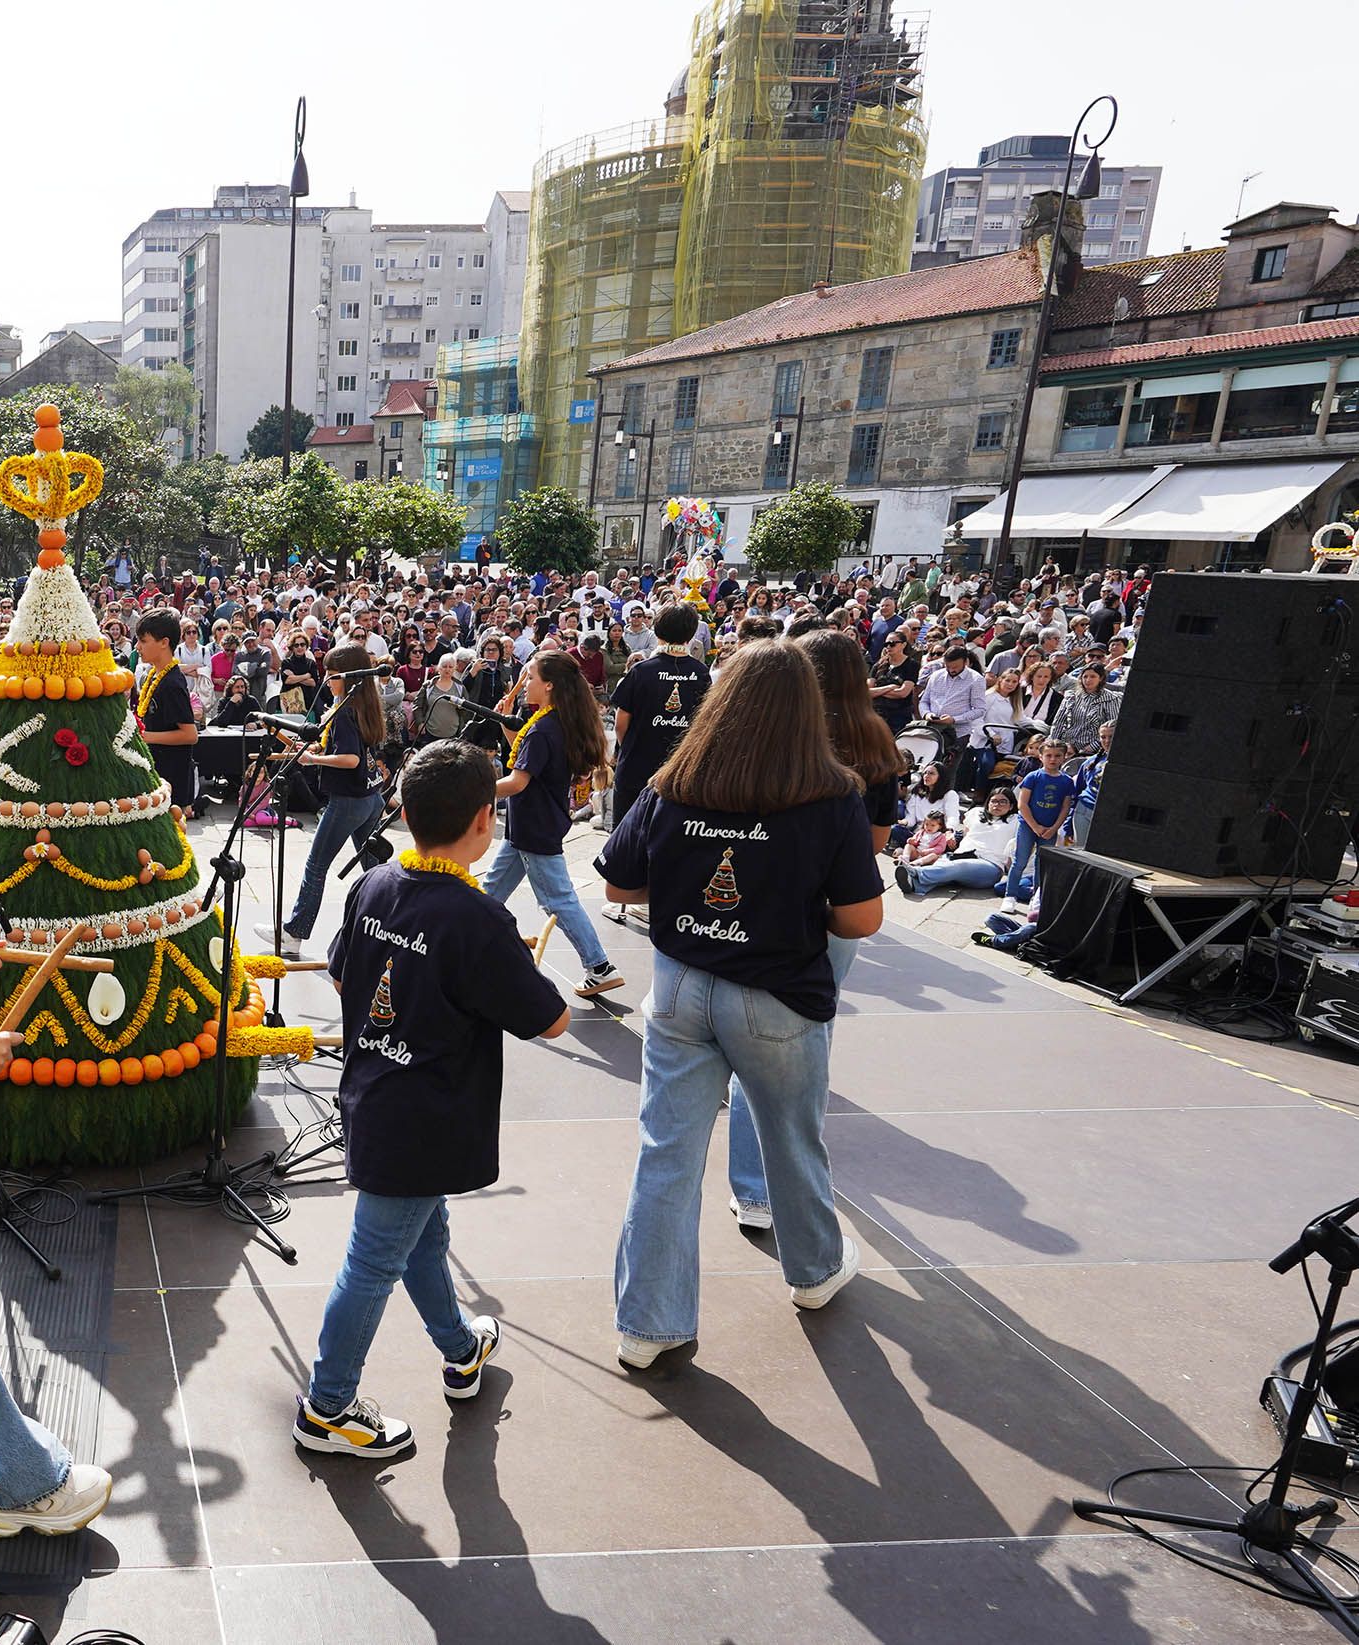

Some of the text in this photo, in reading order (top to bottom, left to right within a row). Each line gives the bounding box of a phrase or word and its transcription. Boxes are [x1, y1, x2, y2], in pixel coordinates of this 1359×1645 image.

[657, 671, 698, 681] Marcos da
[652, 714, 690, 727] Portela
[683, 819, 770, 841] Marcos da
[362, 915, 428, 955] Marcos da
[675, 914, 750, 943] Portela
[357, 1032, 413, 1065] ortela
